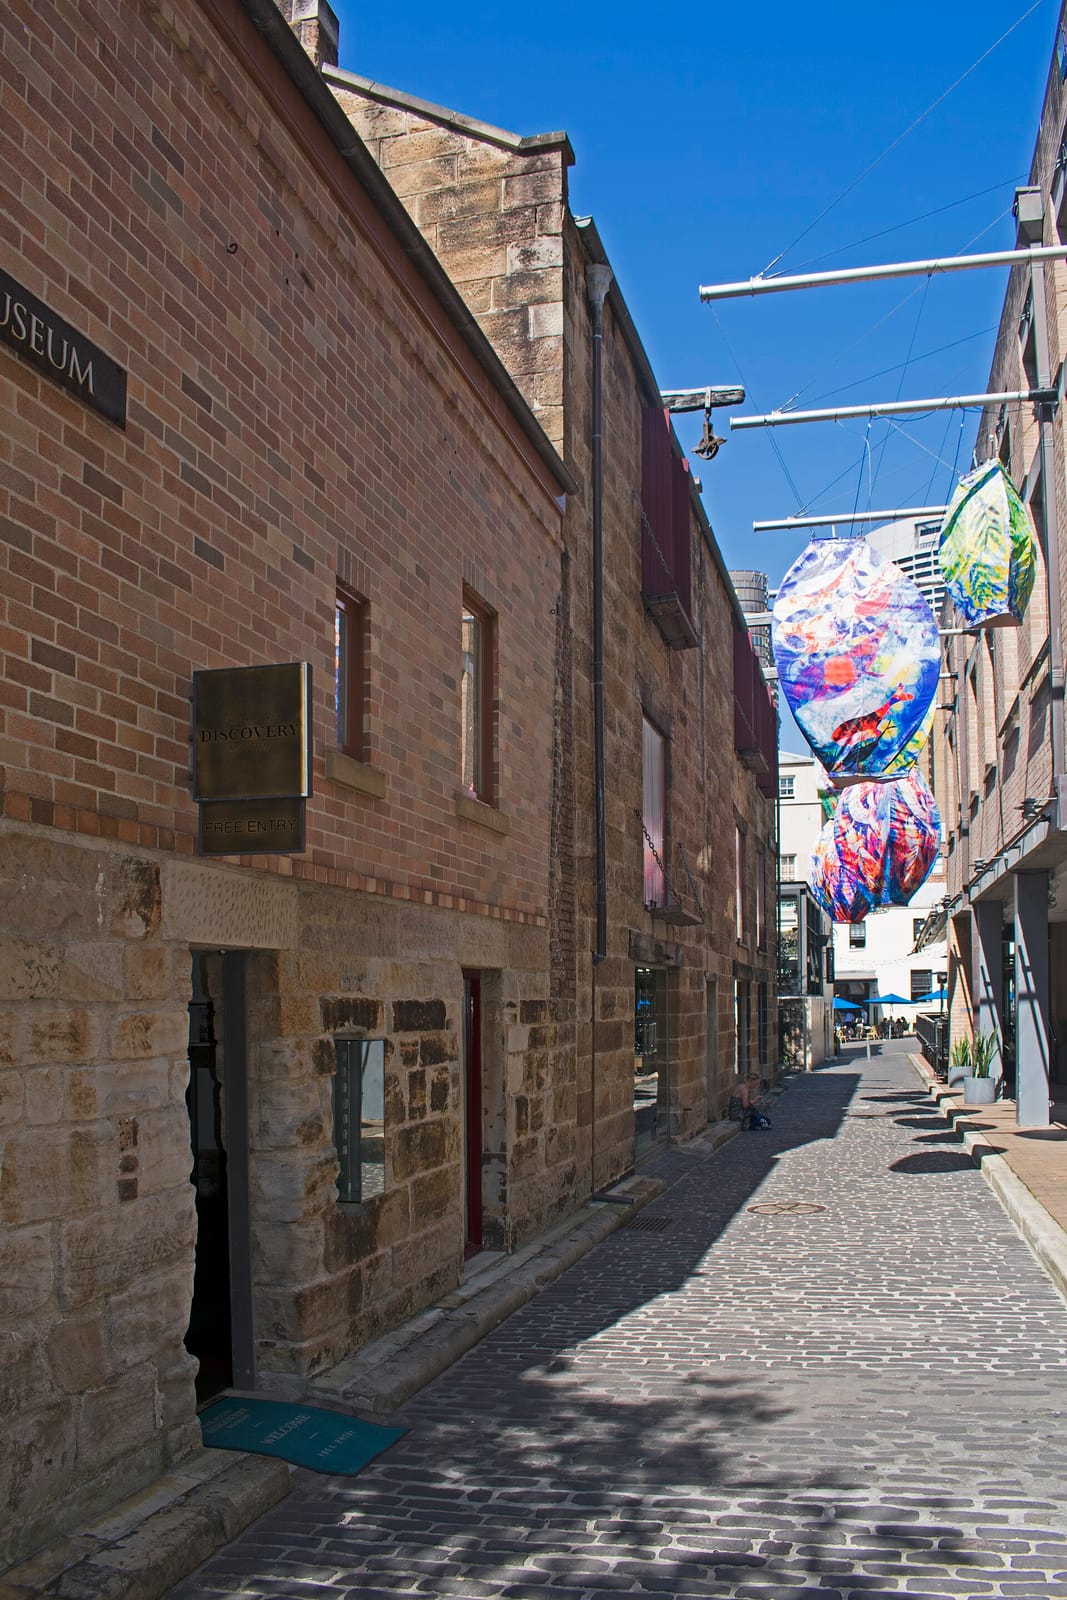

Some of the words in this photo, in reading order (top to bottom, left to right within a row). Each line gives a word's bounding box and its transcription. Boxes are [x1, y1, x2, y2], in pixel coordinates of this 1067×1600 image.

[201, 724, 298, 743] DISCOVERY
[205, 820, 242, 834] FREE
[247, 818, 297, 833] ENTRY
[261, 1415, 311, 1445] WELCOME
